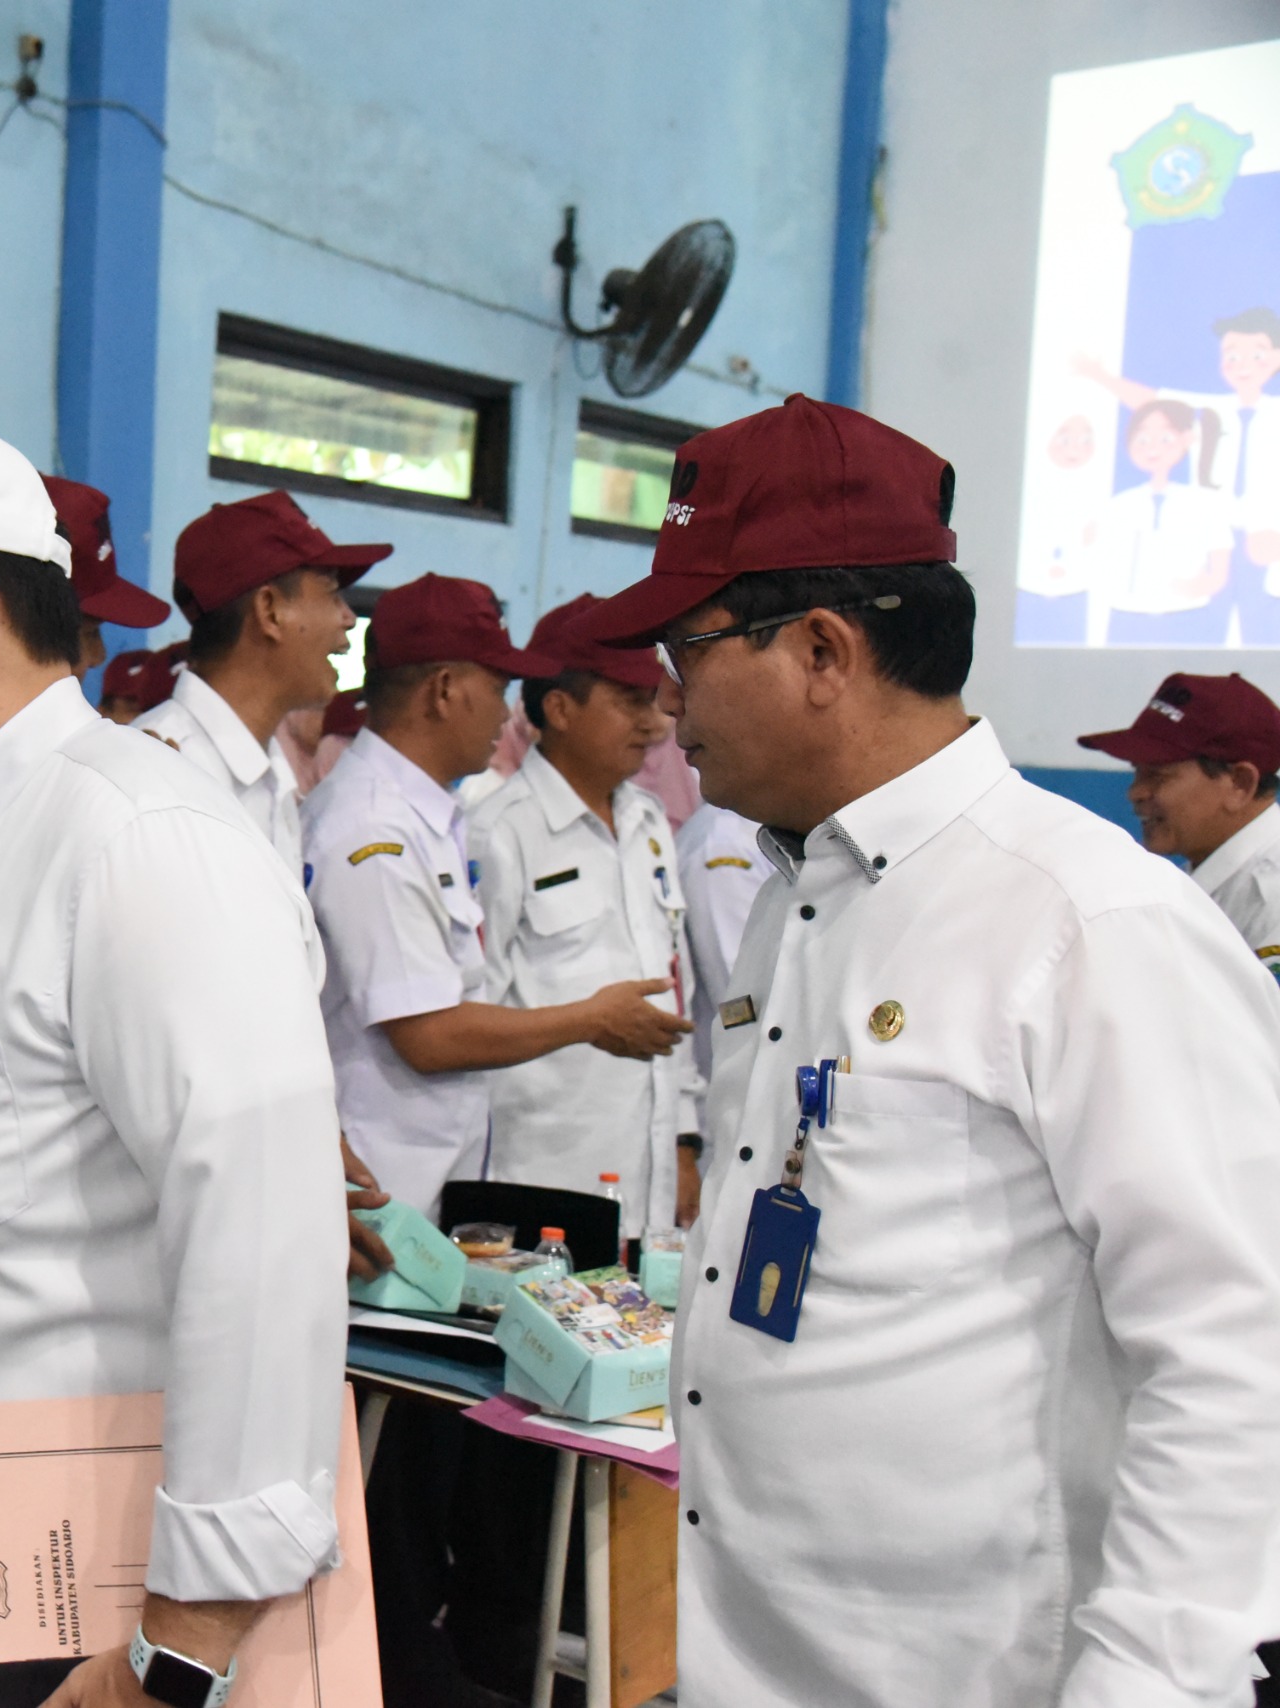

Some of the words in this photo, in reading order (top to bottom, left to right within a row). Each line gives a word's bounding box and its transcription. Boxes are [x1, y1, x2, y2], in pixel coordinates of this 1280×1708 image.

[49, 1529, 63, 1600] INSPEKTUR
[61, 1519, 76, 1580] SIDOARJO
[55, 1602, 68, 1646] UNTUK
[67, 1582, 82, 1656] KABUPATEN
